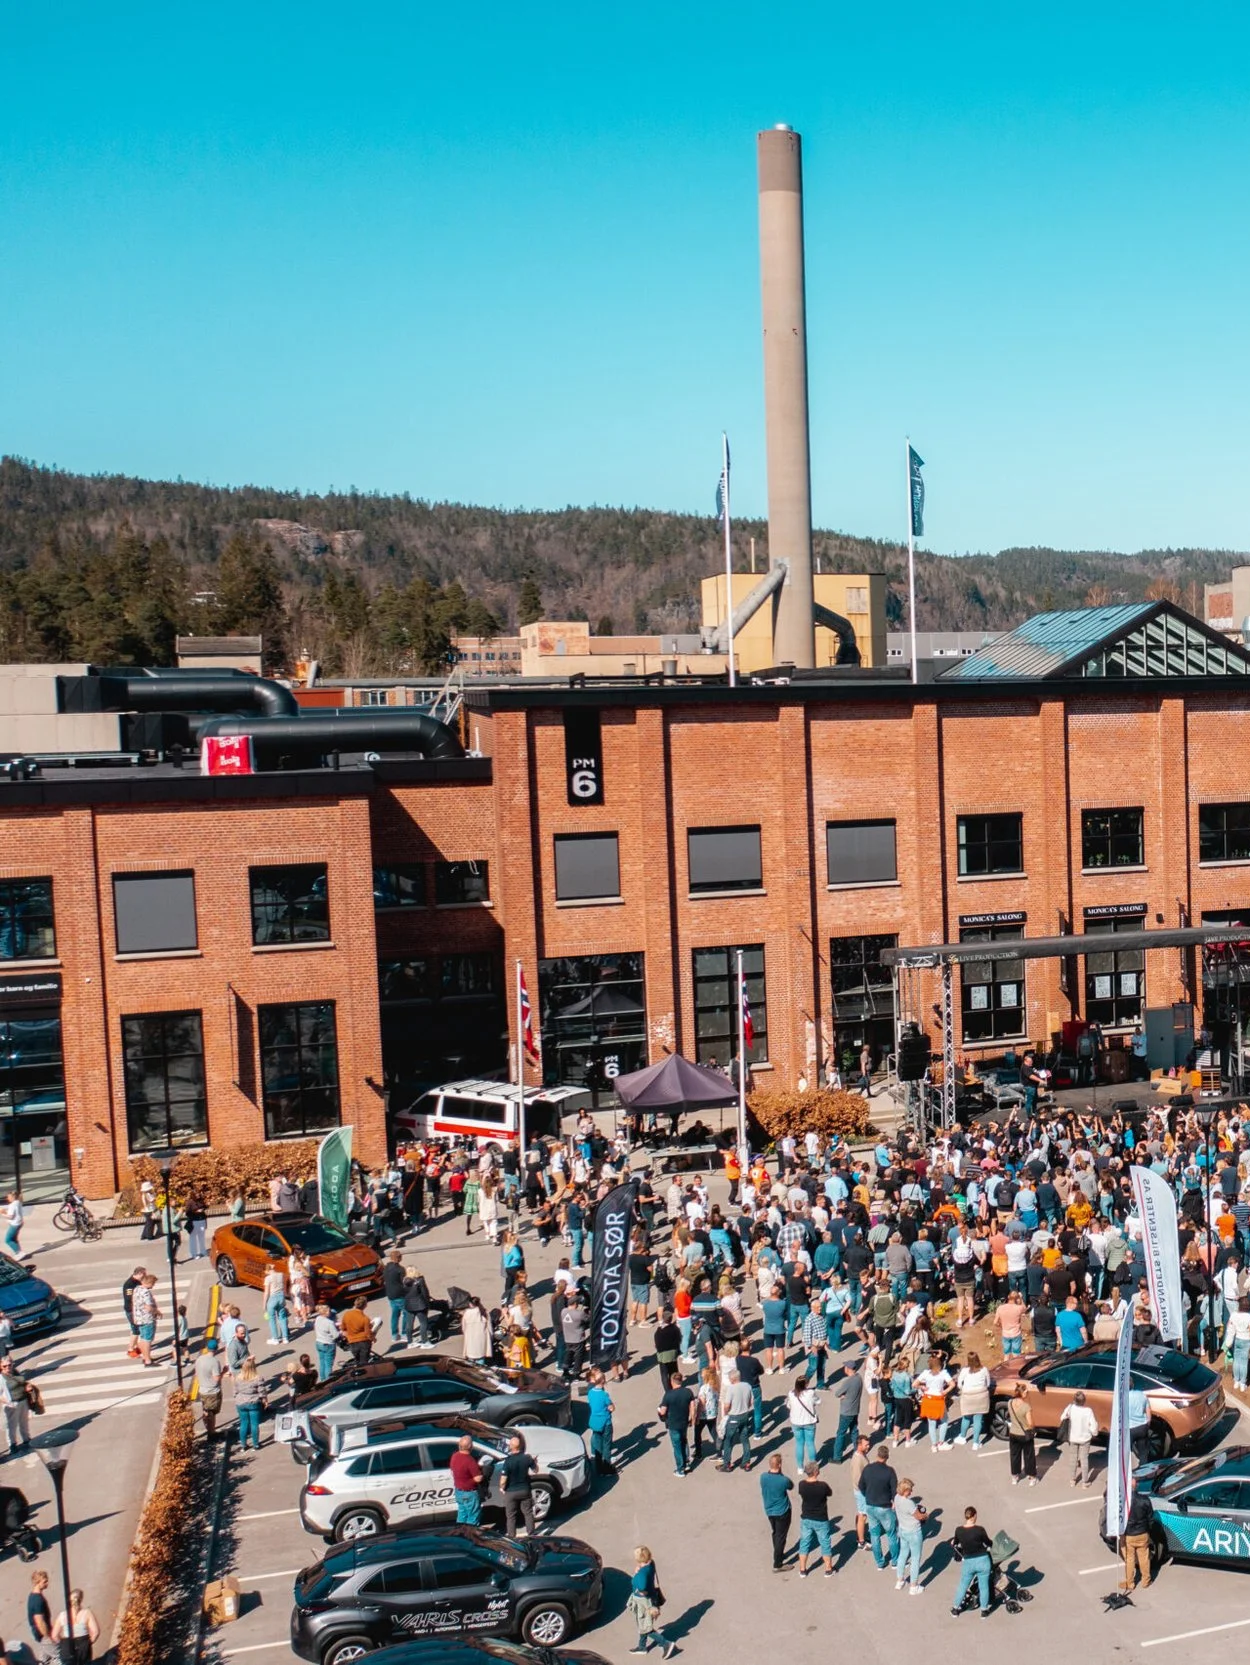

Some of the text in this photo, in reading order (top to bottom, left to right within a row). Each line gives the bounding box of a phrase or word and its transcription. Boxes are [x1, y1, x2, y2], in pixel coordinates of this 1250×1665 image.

[573, 758, 595, 768] PM
[572, 770, 597, 797] 6
[1087, 904, 1144, 915] MONICA'S SALONG
[963, 913, 1023, 923] MONICA'S SALONG
[604, 1055, 618, 1063] PM
[604, 1062, 620, 1079] 6
[600, 1211, 625, 1350] TOYOTA SØR
[390, 1487, 454, 1505] CORO
[408, 1498, 458, 1510] CROS
[391, 1609, 509, 1629] YARIS CROSS
